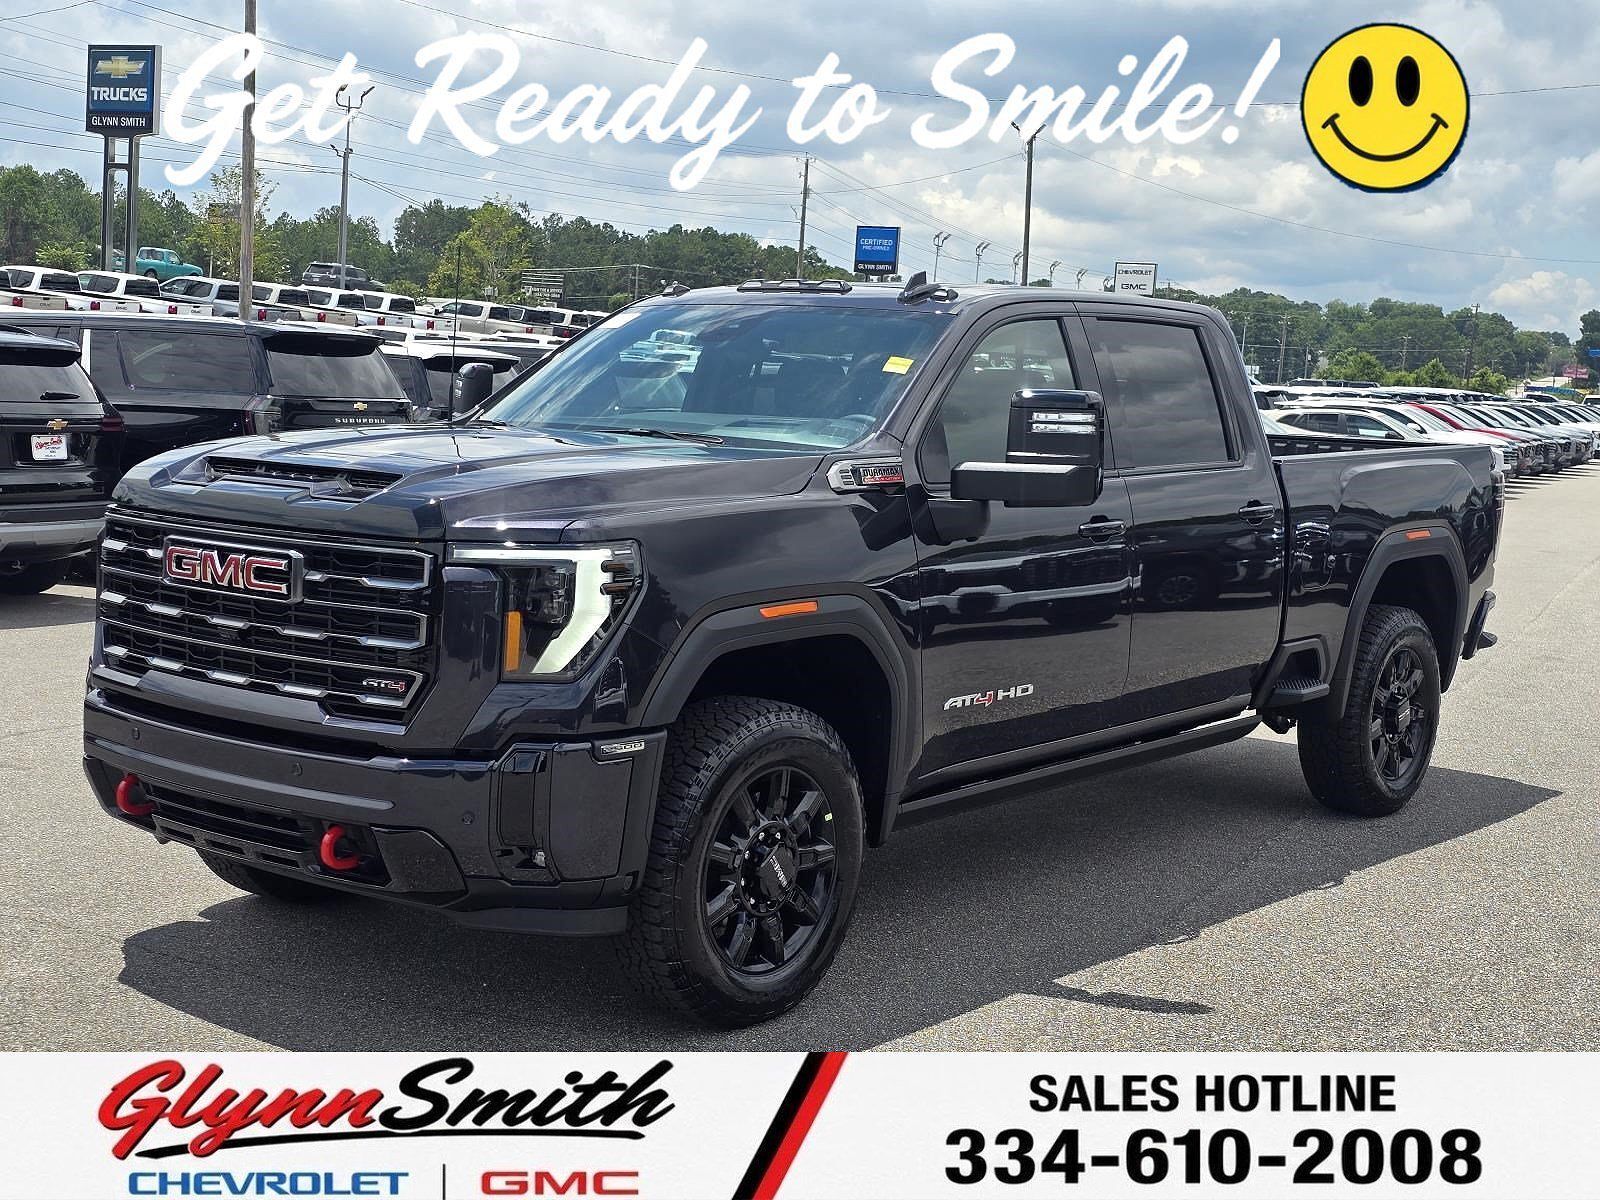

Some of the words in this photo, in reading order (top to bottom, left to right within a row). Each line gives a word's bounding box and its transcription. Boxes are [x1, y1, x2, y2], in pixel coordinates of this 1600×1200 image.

[91, 87, 148, 102] TRUCKS
[91, 116, 118, 127] GLYNN
[120, 117, 146, 127] SMITH
[860, 238, 893, 246] CERTIFIED
[166, 546, 289, 595] GMC
[943, 690, 994, 711] AT4
[997, 683, 1034, 701] HD
